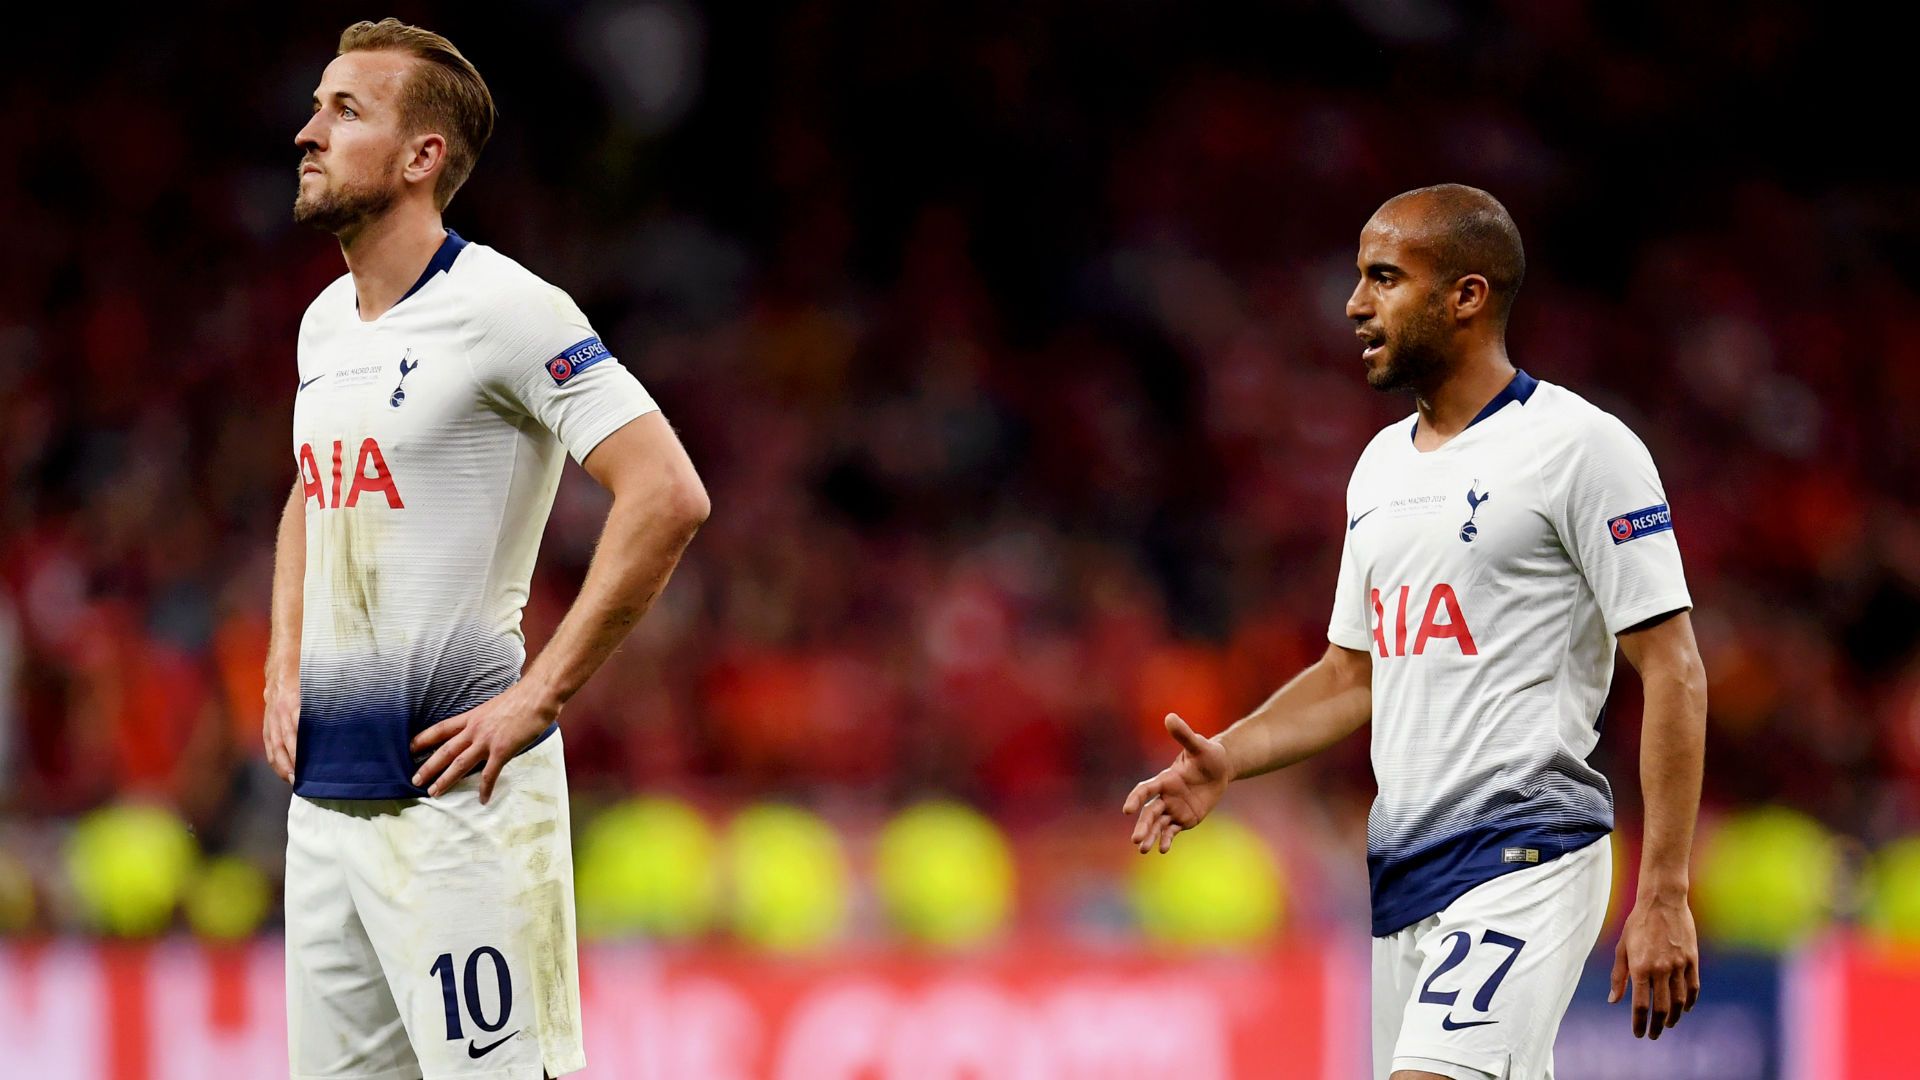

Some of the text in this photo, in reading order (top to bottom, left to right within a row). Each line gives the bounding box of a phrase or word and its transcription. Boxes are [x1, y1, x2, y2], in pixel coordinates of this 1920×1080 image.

[300, 438, 405, 509] AIA
[1371, 583, 1478, 657] AIA
[430, 946, 512, 1040] 10
[1419, 929, 1526, 1012] 27
